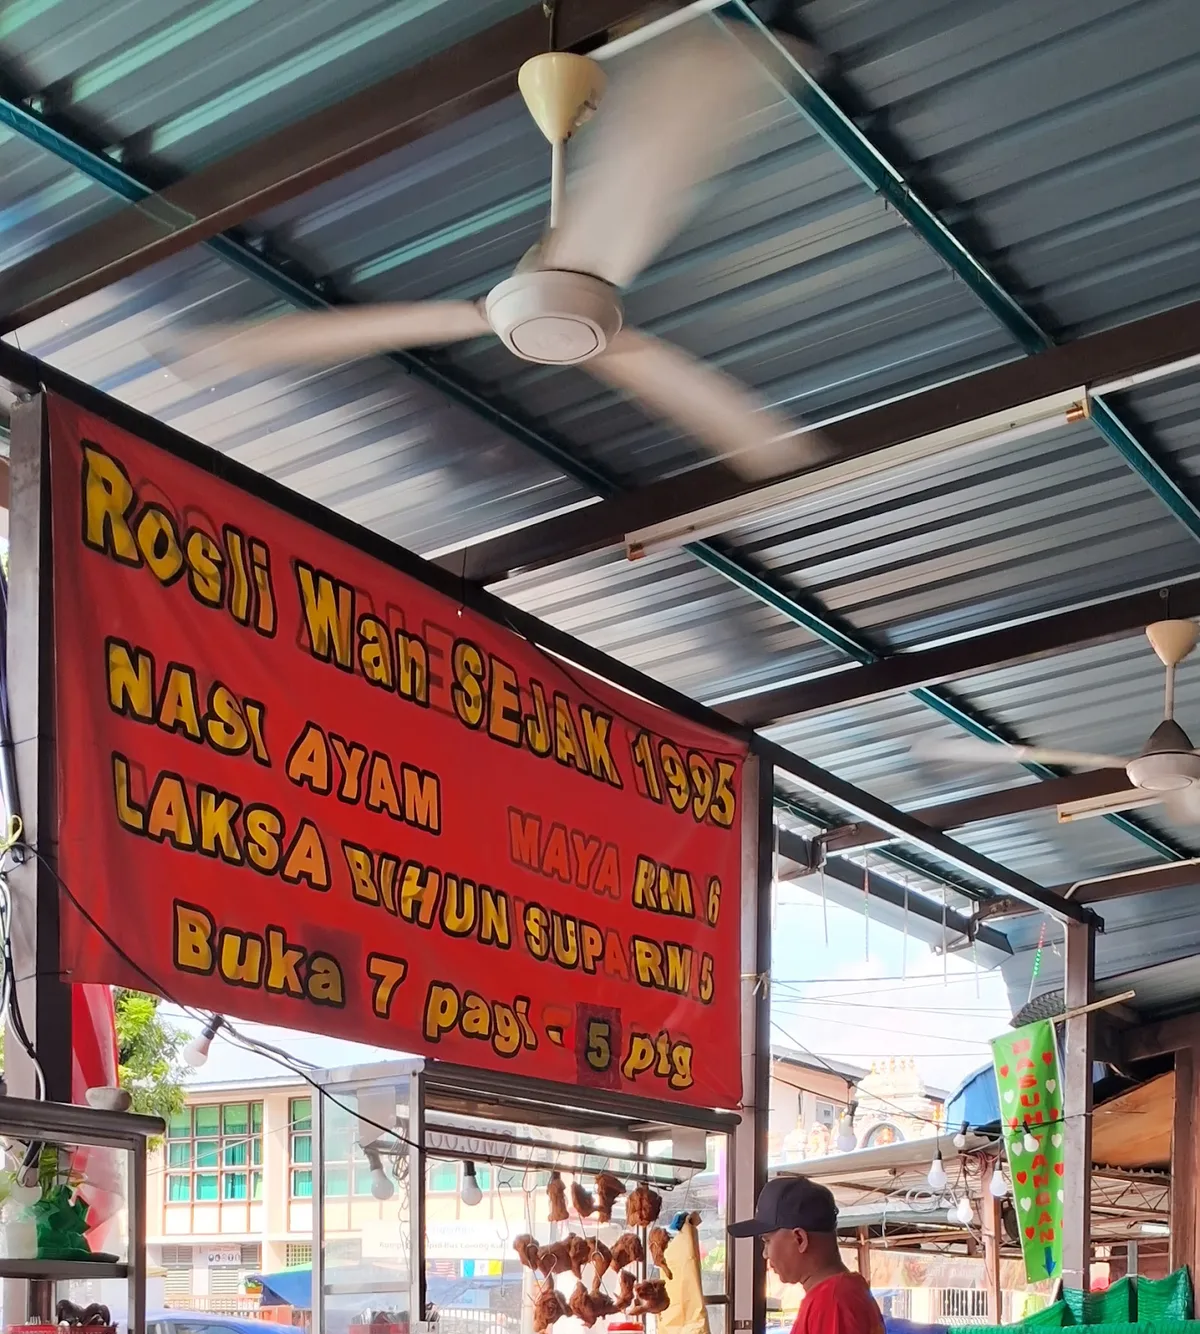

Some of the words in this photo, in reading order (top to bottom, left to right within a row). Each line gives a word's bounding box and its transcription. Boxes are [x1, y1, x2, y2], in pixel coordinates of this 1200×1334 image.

[80, 437, 278, 640] Rosli
[294, 557, 430, 708] Wan
[450, 637, 624, 790] SEJAK
[629, 732, 737, 830] 1995
[104, 635, 272, 769] NASI
[285, 722, 442, 836] AYAM
[506, 806, 622, 900] MAYA
[631, 853, 696, 919] RM
[706, 874, 722, 929] 6
[111, 751, 331, 893] LAKSA
[341, 839, 512, 951] BIHUN
[631, 934, 693, 997] RM
[698, 951, 714, 1005] 5
[172, 897, 346, 1008] Buka
[366, 952, 409, 1019] 7
[423, 980, 539, 1059] pagi
[585, 1017, 613, 1073] 5
[621, 1029, 695, 1091] ptg
